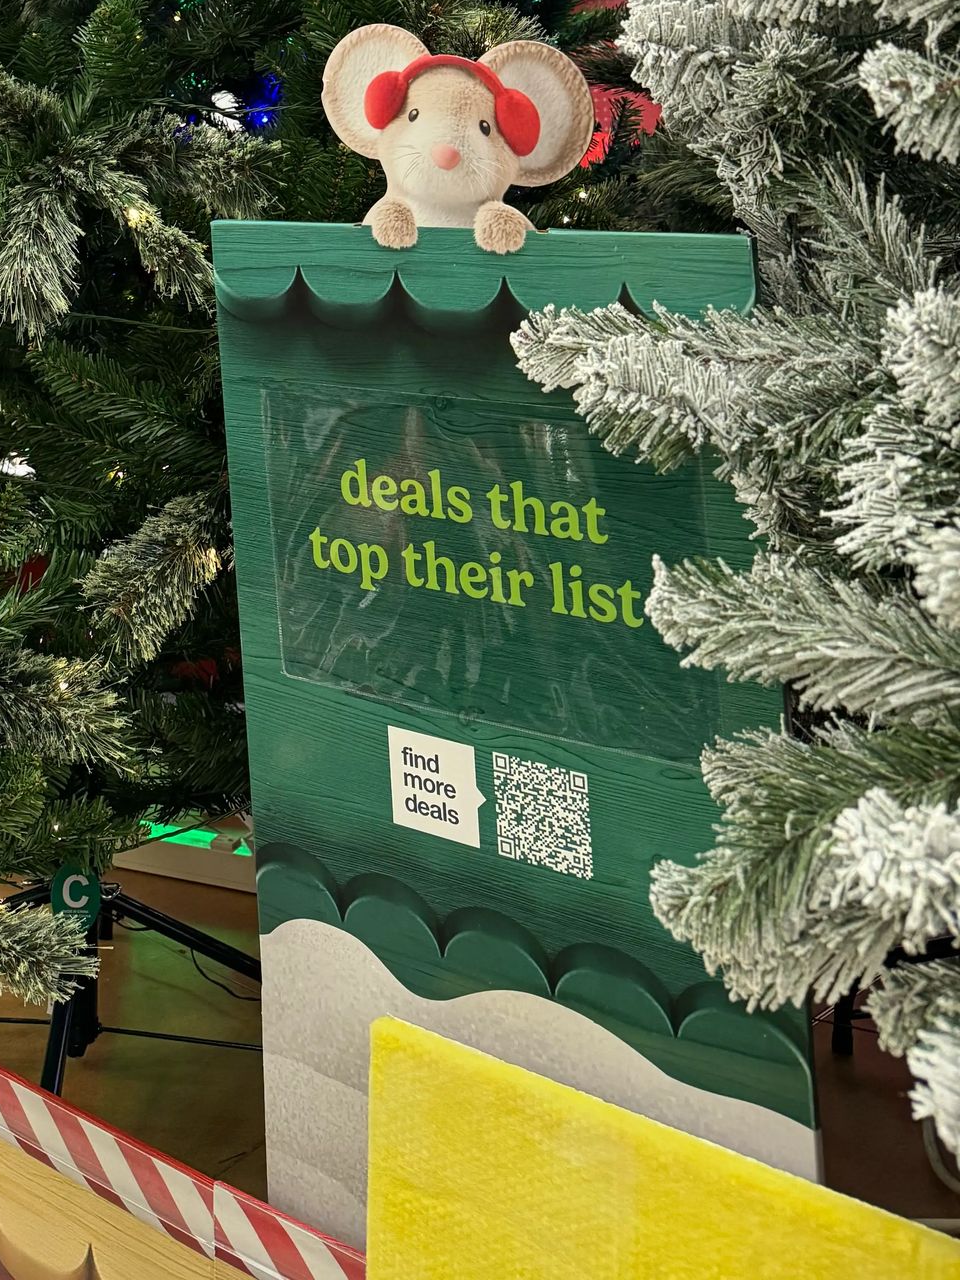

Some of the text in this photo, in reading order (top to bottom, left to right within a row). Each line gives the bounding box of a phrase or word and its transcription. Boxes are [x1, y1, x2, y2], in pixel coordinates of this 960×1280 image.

[340, 458, 609, 545] deals that
[308, 526, 644, 628] top their list
[401, 746, 440, 774] find
[403, 771, 456, 799] more
[405, 794, 460, 825] deals
[62, 874, 89, 908] C
